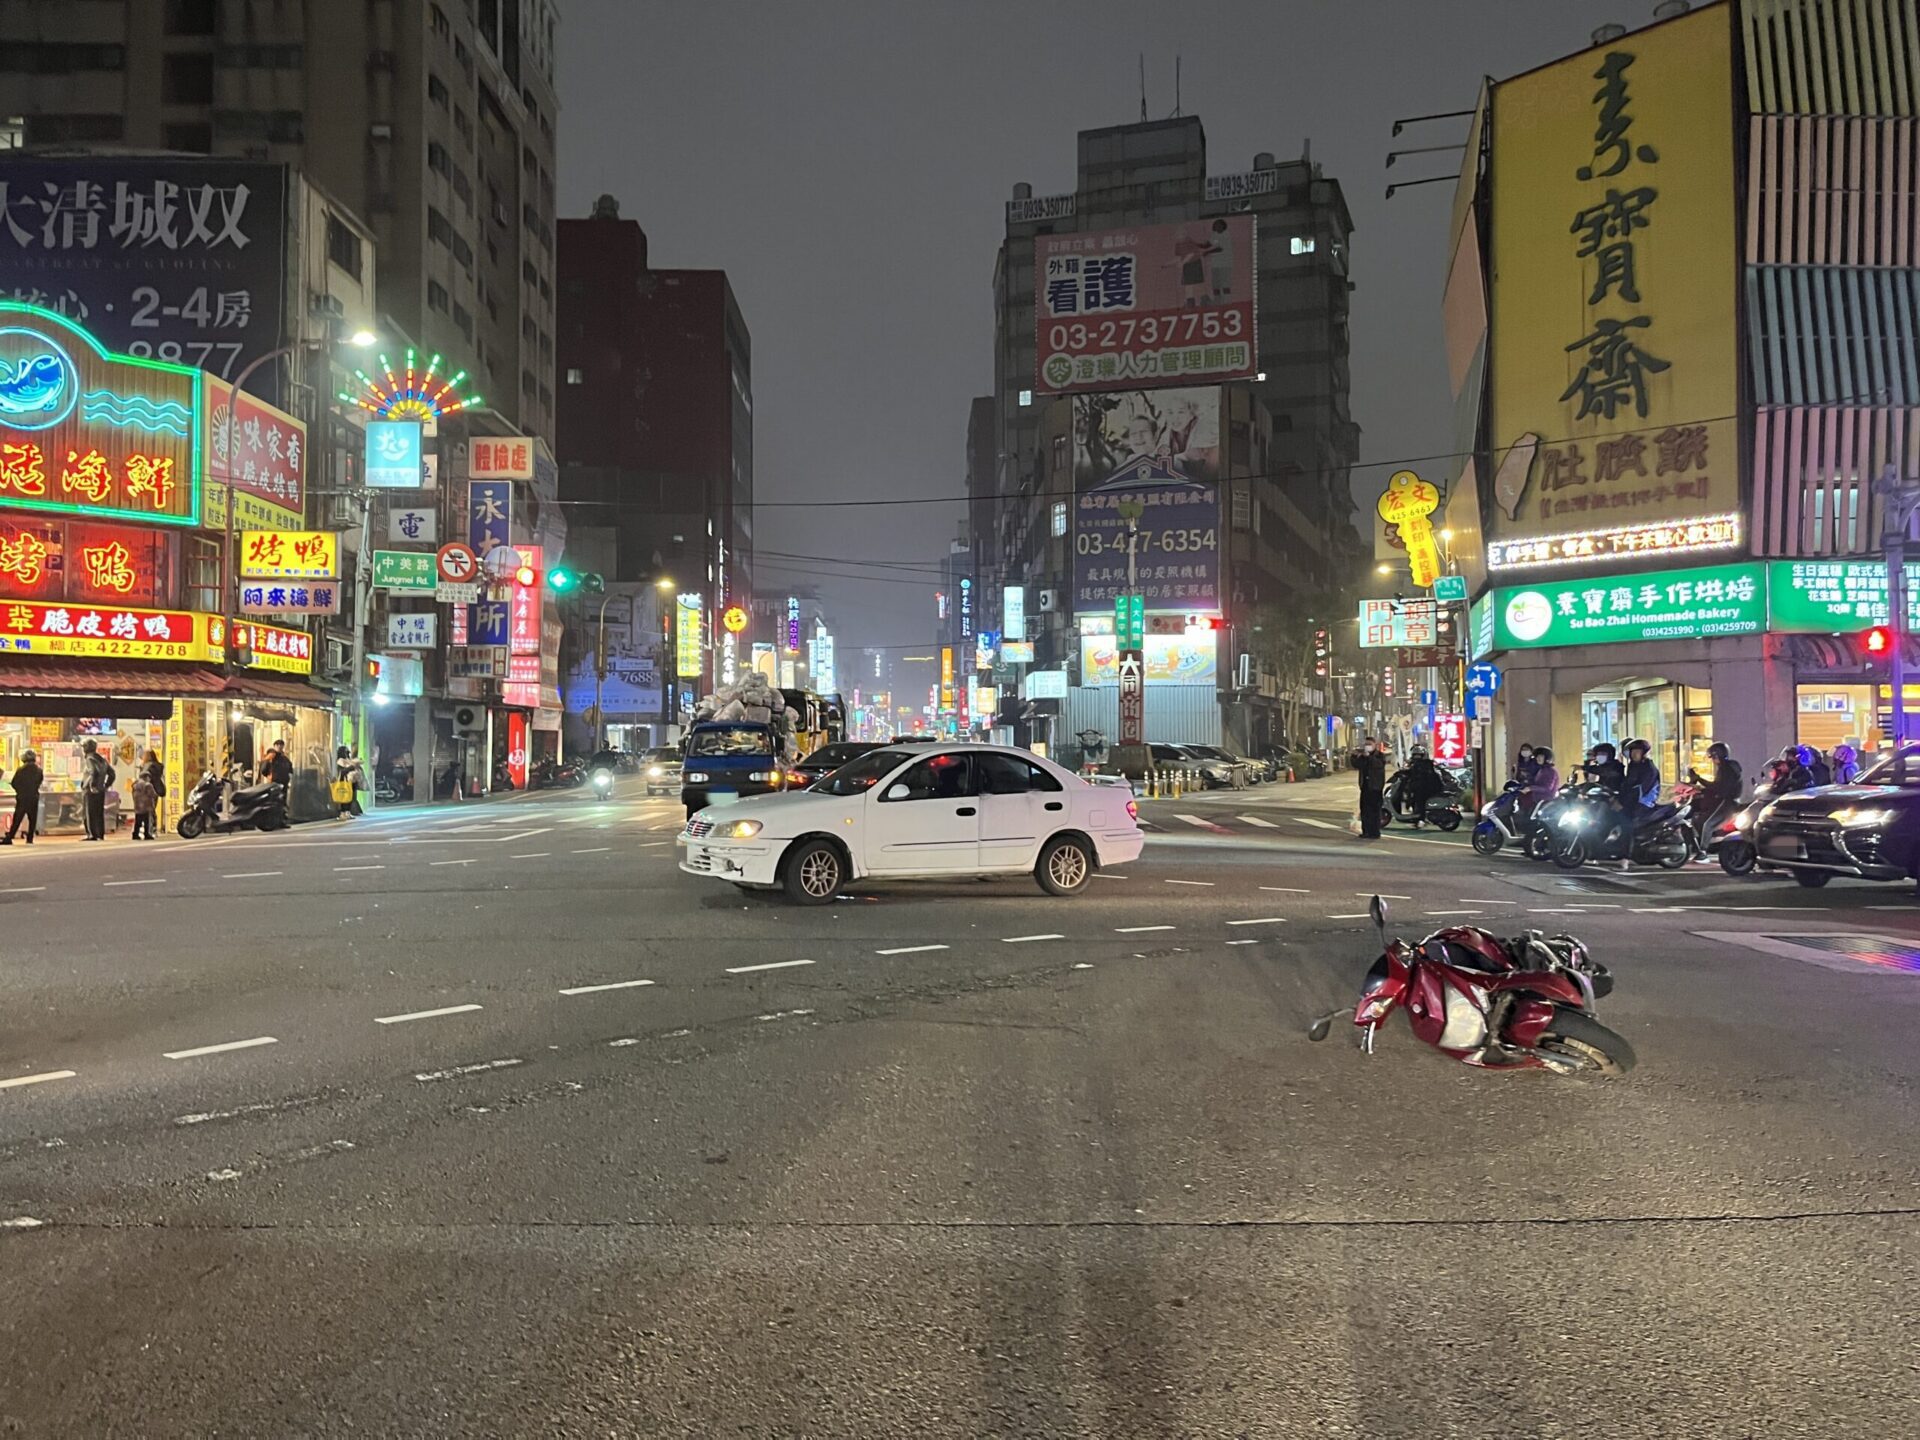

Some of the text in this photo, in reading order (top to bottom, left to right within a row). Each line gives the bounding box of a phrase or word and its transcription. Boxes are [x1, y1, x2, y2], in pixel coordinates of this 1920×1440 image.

[1559, 51, 1671, 421] 素寶齋
[1050, 310, 1241, 350] 03-2737753
[399, 513, 425, 538] 電
[249, 534, 328, 567] 烤鴨
[382, 556, 429, 571] 中美路
[1792, 564, 1842, 577] 生日蛋糕
[1556, 576, 1755, 616] 素寶齋手作烘焙
[1570, 608, 1740, 629] Su Bao Zhai Homemade Bakery
[1642, 621, 1757, 637] (03)4251990 (03)4259709
